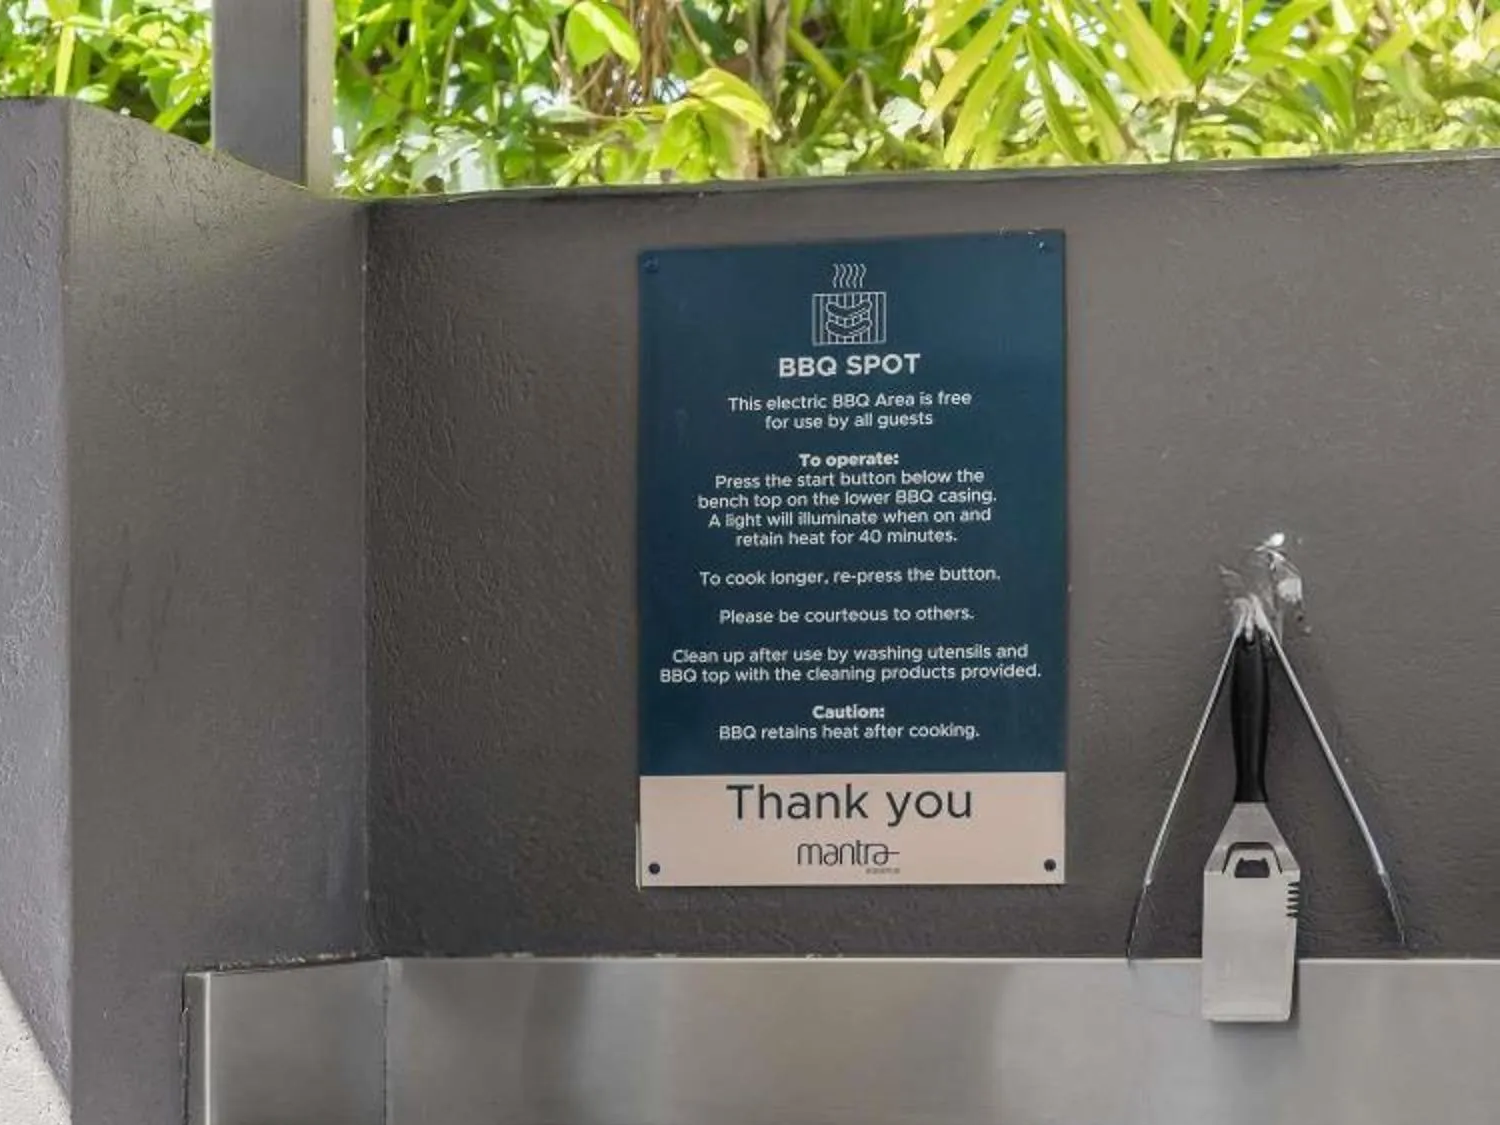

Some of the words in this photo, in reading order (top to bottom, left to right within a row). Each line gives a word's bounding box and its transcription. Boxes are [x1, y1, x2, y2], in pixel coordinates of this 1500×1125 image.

[778, 356, 838, 378] BBQ
[845, 352, 921, 376] SPOT
[727, 395, 763, 412] This
[765, 393, 828, 411] electric
[831, 393, 871, 409] BBQ
[873, 392, 916, 407] Area
[919, 391, 933, 406] is
[937, 390, 973, 405] free
[764, 415, 790, 431] for
[793, 416, 824, 429] use
[827, 413, 850, 431] by
[853, 411, 873, 428] all
[876, 411, 934, 430] guests
[798, 453, 822, 468] To
[825, 451, 900, 470] operate:
[715, 474, 761, 489] Press
[764, 473, 793, 489] the
[796, 471, 835, 488] start
[839, 471, 897, 487] button
[900, 469, 953, 485] below
[955, 467, 985, 484] the
[697, 493, 749, 509] bench
[753, 493, 783, 511] top
[786, 494, 809, 507] on
[811, 491, 841, 507] the
[844, 490, 891, 506] lower
[895, 488, 935, 505] BBQ
[937, 486, 997, 506] casing.
[707, 513, 722, 528] A
[725, 512, 763, 531] light
[766, 510, 794, 527] will
[797, 509, 879, 526] illuminate
[882, 508, 930, 524] when
[932, 510, 956, 523] on
[959, 506, 992, 523] and
[735, 531, 784, 547] retain
[788, 531, 826, 545] heat
[829, 529, 855, 545] for
[858, 528, 883, 544] 40
[887, 527, 958, 544] minutes.
[699, 571, 721, 587] To
[725, 570, 767, 586] cook
[833, 569, 903, 586] re-press
[906, 567, 935, 583] the
[939, 566, 1001, 582] button.
[719, 609, 775, 625] Please
[778, 608, 801, 624] be
[803, 607, 889, 623] courteous
[892, 607, 912, 622] to
[914, 604, 975, 621] others.
[672, 648, 719, 664] Clean
[723, 650, 745, 666] up
[749, 647, 789, 663] after
[792, 649, 823, 663] use
[827, 646, 849, 665] by
[853, 644, 923, 663] washing
[926, 643, 993, 660] utensils
[995, 643, 1029, 660] and
[659, 667, 698, 683] BBQ
[701, 668, 731, 686] top
[734, 666, 770, 682] with
[773, 666, 803, 682] the
[805, 665, 877, 683] cleaning
[880, 664, 957, 683] products
[960, 663, 1042, 682] provided.
[811, 703, 885, 720] Caution:
[718, 725, 757, 741] BBQ
[760, 724, 818, 740] retains
[821, 723, 860, 739] heat
[863, 723, 905, 739] after
[908, 721, 981, 741] cooking.
[725, 783, 869, 821] Thank
[885, 790, 972, 827] you
[797, 839, 901, 867] mantra
